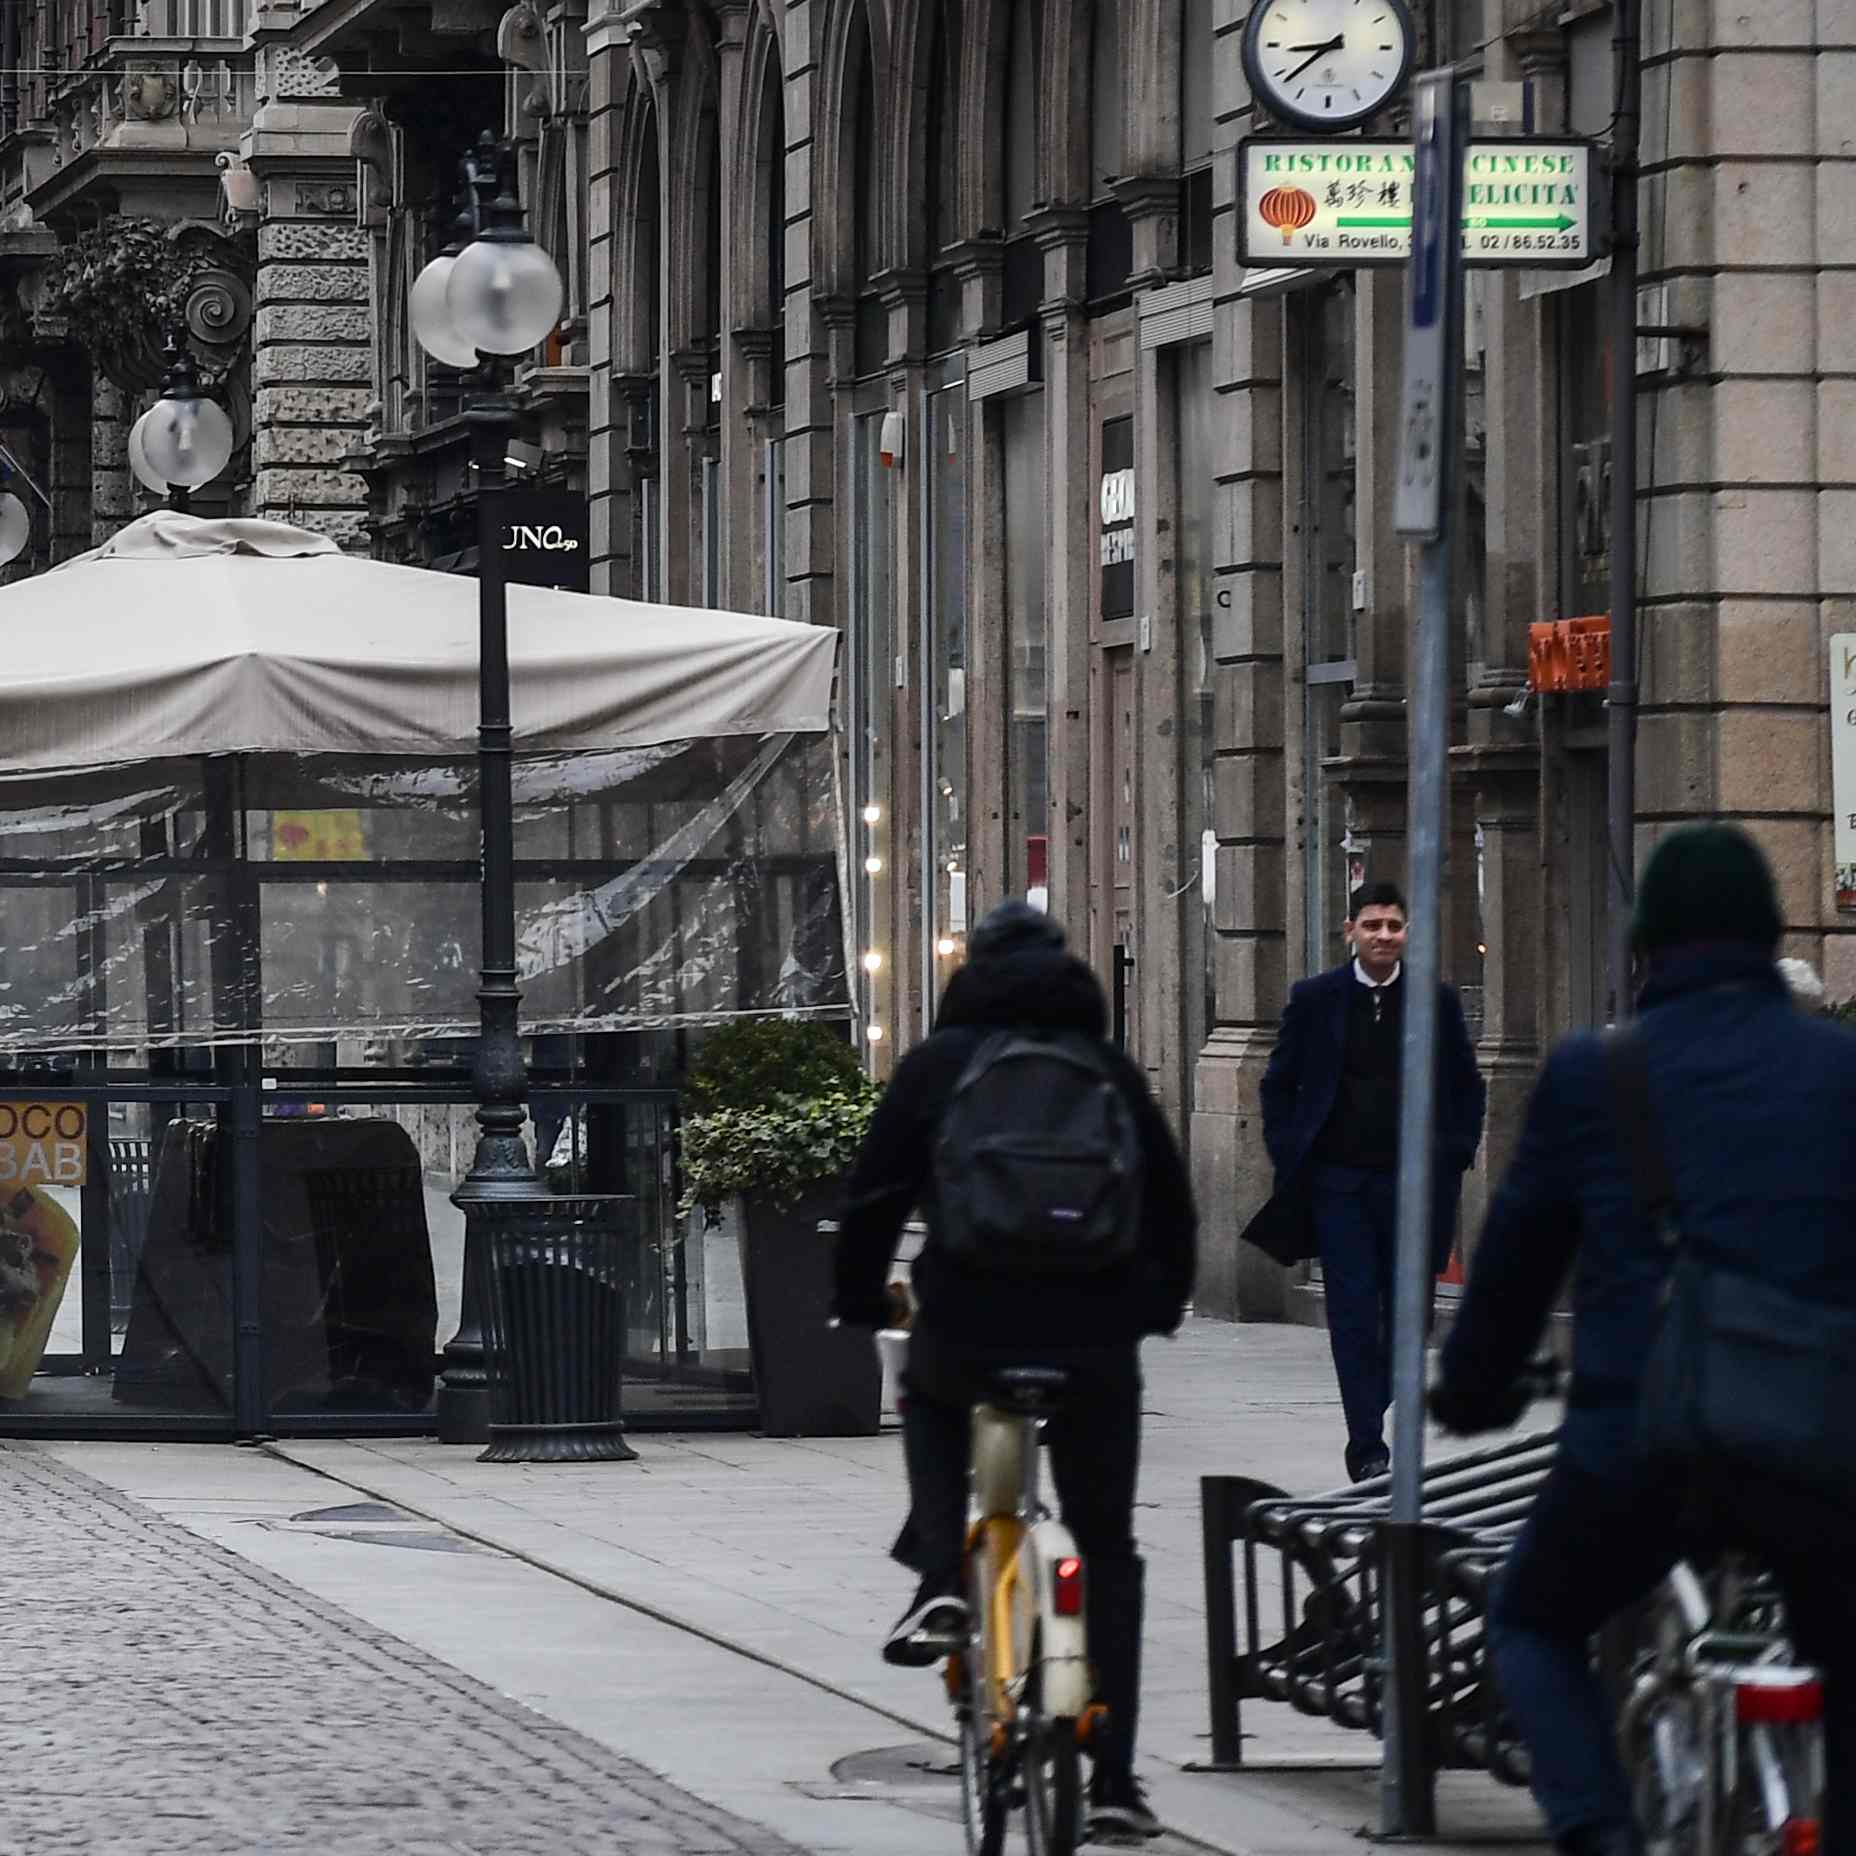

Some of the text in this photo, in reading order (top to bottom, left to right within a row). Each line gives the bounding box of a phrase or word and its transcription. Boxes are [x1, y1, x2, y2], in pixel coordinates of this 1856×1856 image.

[1264, 154, 1575, 174] RISTORAN CINESE
[1469, 183, 1579, 205] ELICITA'
[1304, 233, 1330, 248] Via
[1338, 233, 1404, 251] Rovello,
